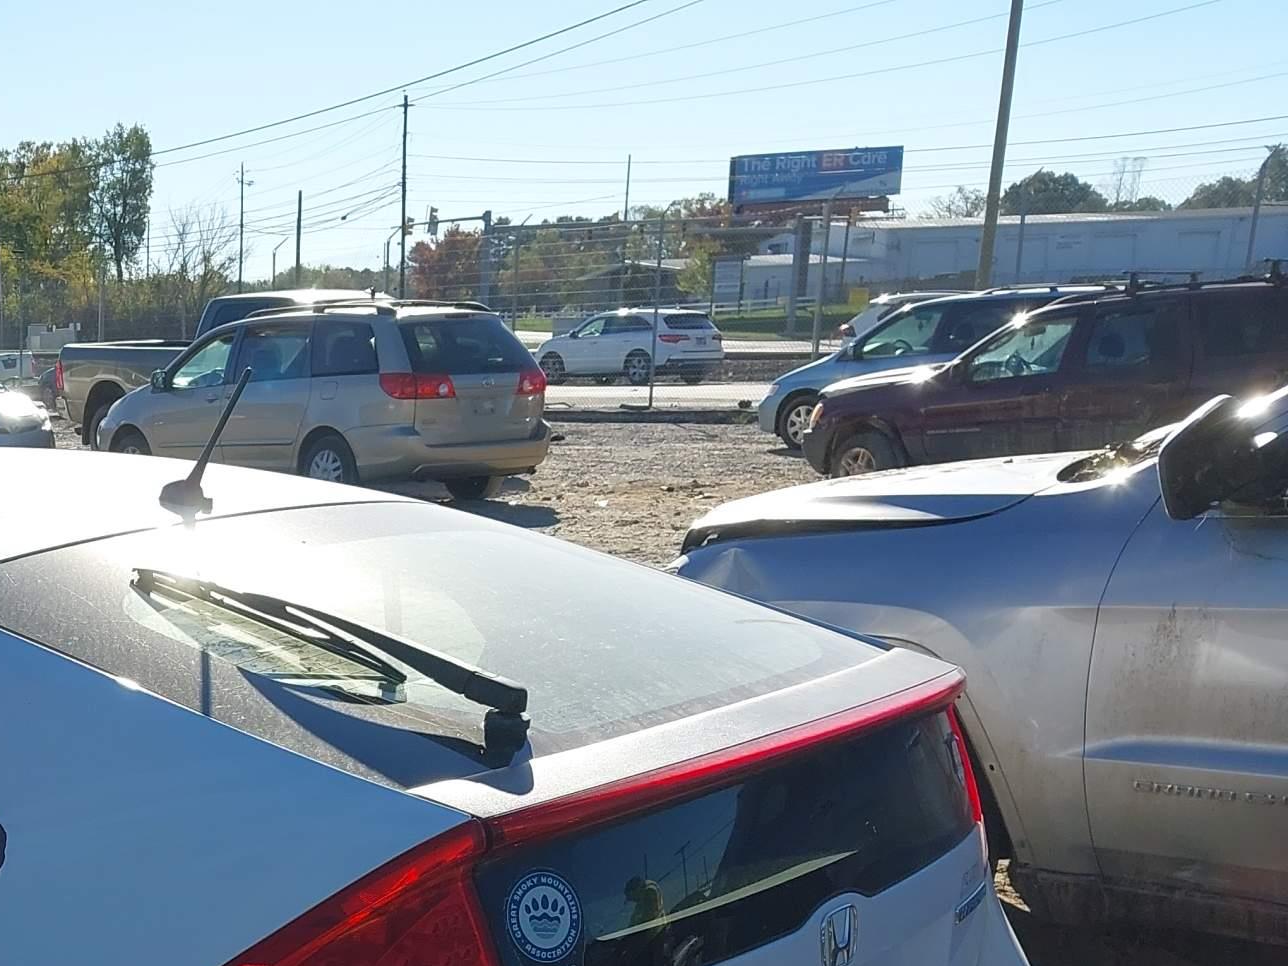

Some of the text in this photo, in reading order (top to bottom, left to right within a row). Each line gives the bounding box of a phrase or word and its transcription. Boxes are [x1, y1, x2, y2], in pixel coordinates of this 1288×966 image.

[743, 151, 887, 172] The Right ER Care
[510, 876, 578, 939] GREAT SMOKY MOUNTAINS
[525, 928, 576, 958] ASSOCIATION
